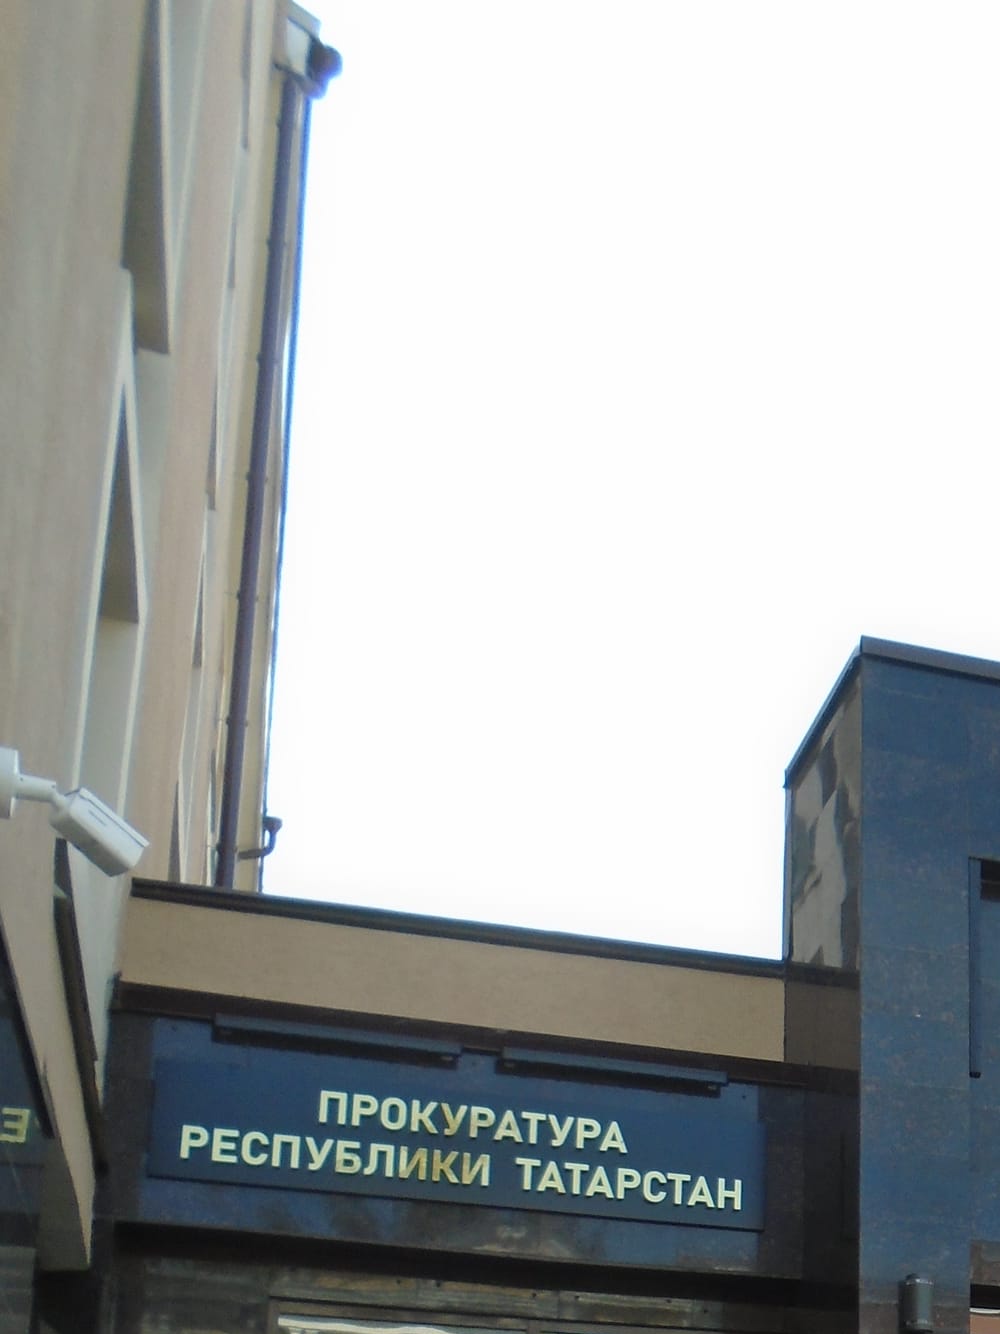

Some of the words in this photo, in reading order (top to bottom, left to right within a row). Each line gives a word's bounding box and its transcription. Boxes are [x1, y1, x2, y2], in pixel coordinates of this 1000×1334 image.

[318, 1090, 628, 1155] ПРОКУРАТУРА
[179, 1124, 490, 1188] РЕСПУБЛИКИ
[515, 1157, 742, 1212] ТАТАРСТАН
